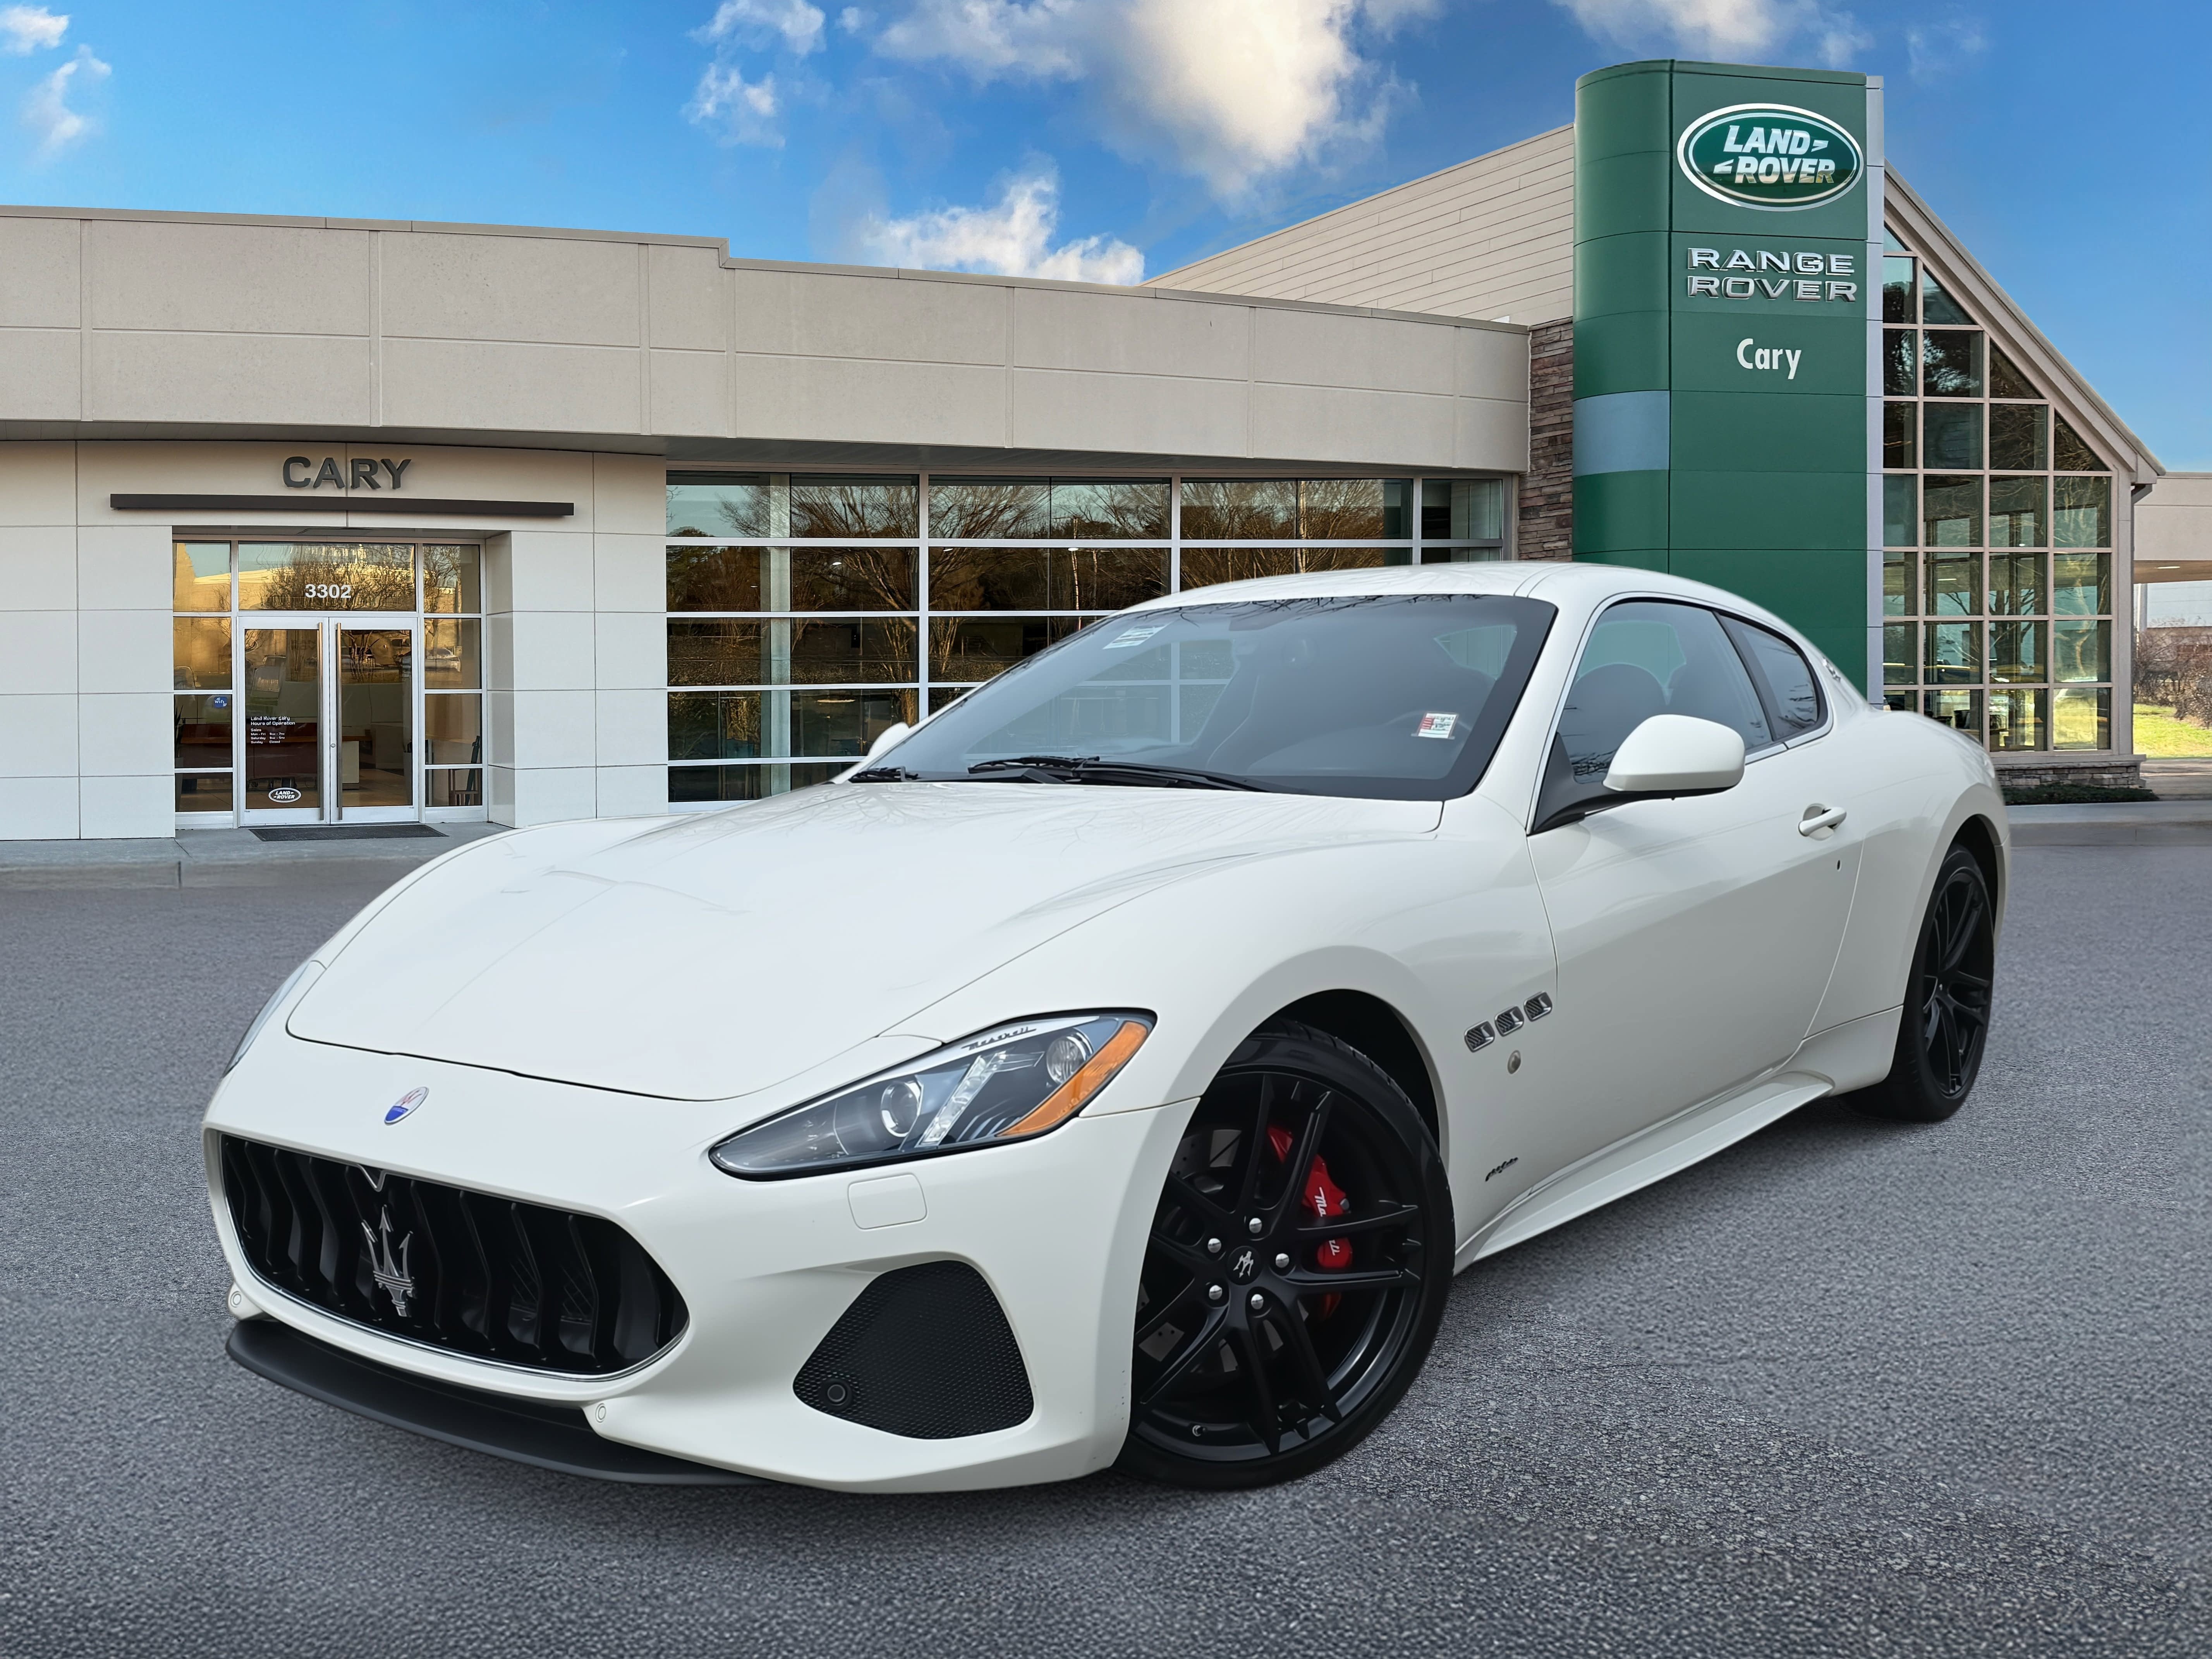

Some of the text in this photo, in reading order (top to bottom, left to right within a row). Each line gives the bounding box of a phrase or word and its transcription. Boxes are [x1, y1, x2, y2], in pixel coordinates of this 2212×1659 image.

[1723, 125, 1811, 155] LAND
[1734, 156, 1836, 184] ROVER
[1687, 248, 1855, 276] RANGE
[1687, 276, 1858, 303] ROVER
[1737, 338, 1802, 380] Cary
[283, 456, 412, 489] CARY
[305, 584, 351, 598] 3302
